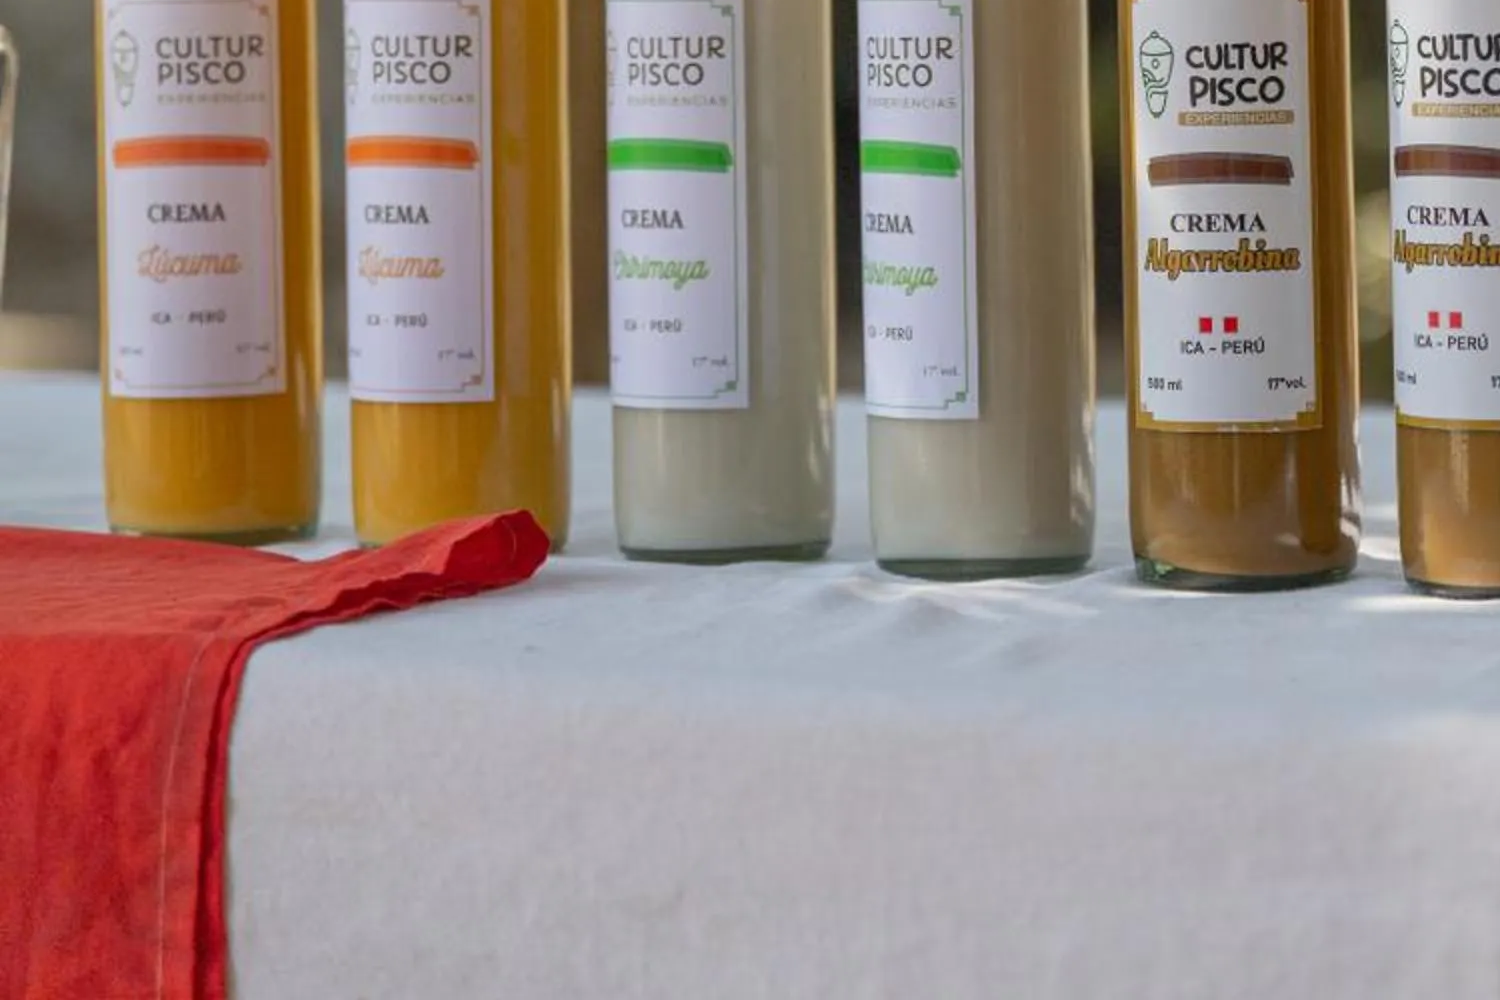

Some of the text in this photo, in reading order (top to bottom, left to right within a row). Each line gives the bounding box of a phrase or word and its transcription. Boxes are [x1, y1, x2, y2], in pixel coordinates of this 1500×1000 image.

[155, 34, 264, 59] CULTUR
[371, 35, 473, 59] CULTUR
[626, 35, 726, 59] CULTUR
[866, 36, 955, 60] CULTUR
[1185, 40, 1289, 71] CULTUR
[157, 60, 246, 85] PISCO
[372, 60, 452, 85] PISCO
[627, 62, 705, 87] PISCO
[866, 63, 934, 88] PISCO
[1190, 75, 1286, 107] PISCO
[147, 202, 226, 224] CREMA
[364, 204, 430, 225] CREMA
[621, 209, 685, 230] CREMA
[1170, 212, 1267, 234] CREMA
[1406, 204, 1491, 228] CREMA
[1144, 237, 1302, 281] Algarrobina
[884, 325, 914, 342] PERÚ
[1180, 339, 1205, 355] ICA
[1221, 334, 1265, 355] PERÚ
[1414, 334, 1434, 349] ICA
[1447, 331, 1490, 351] PERÚ
